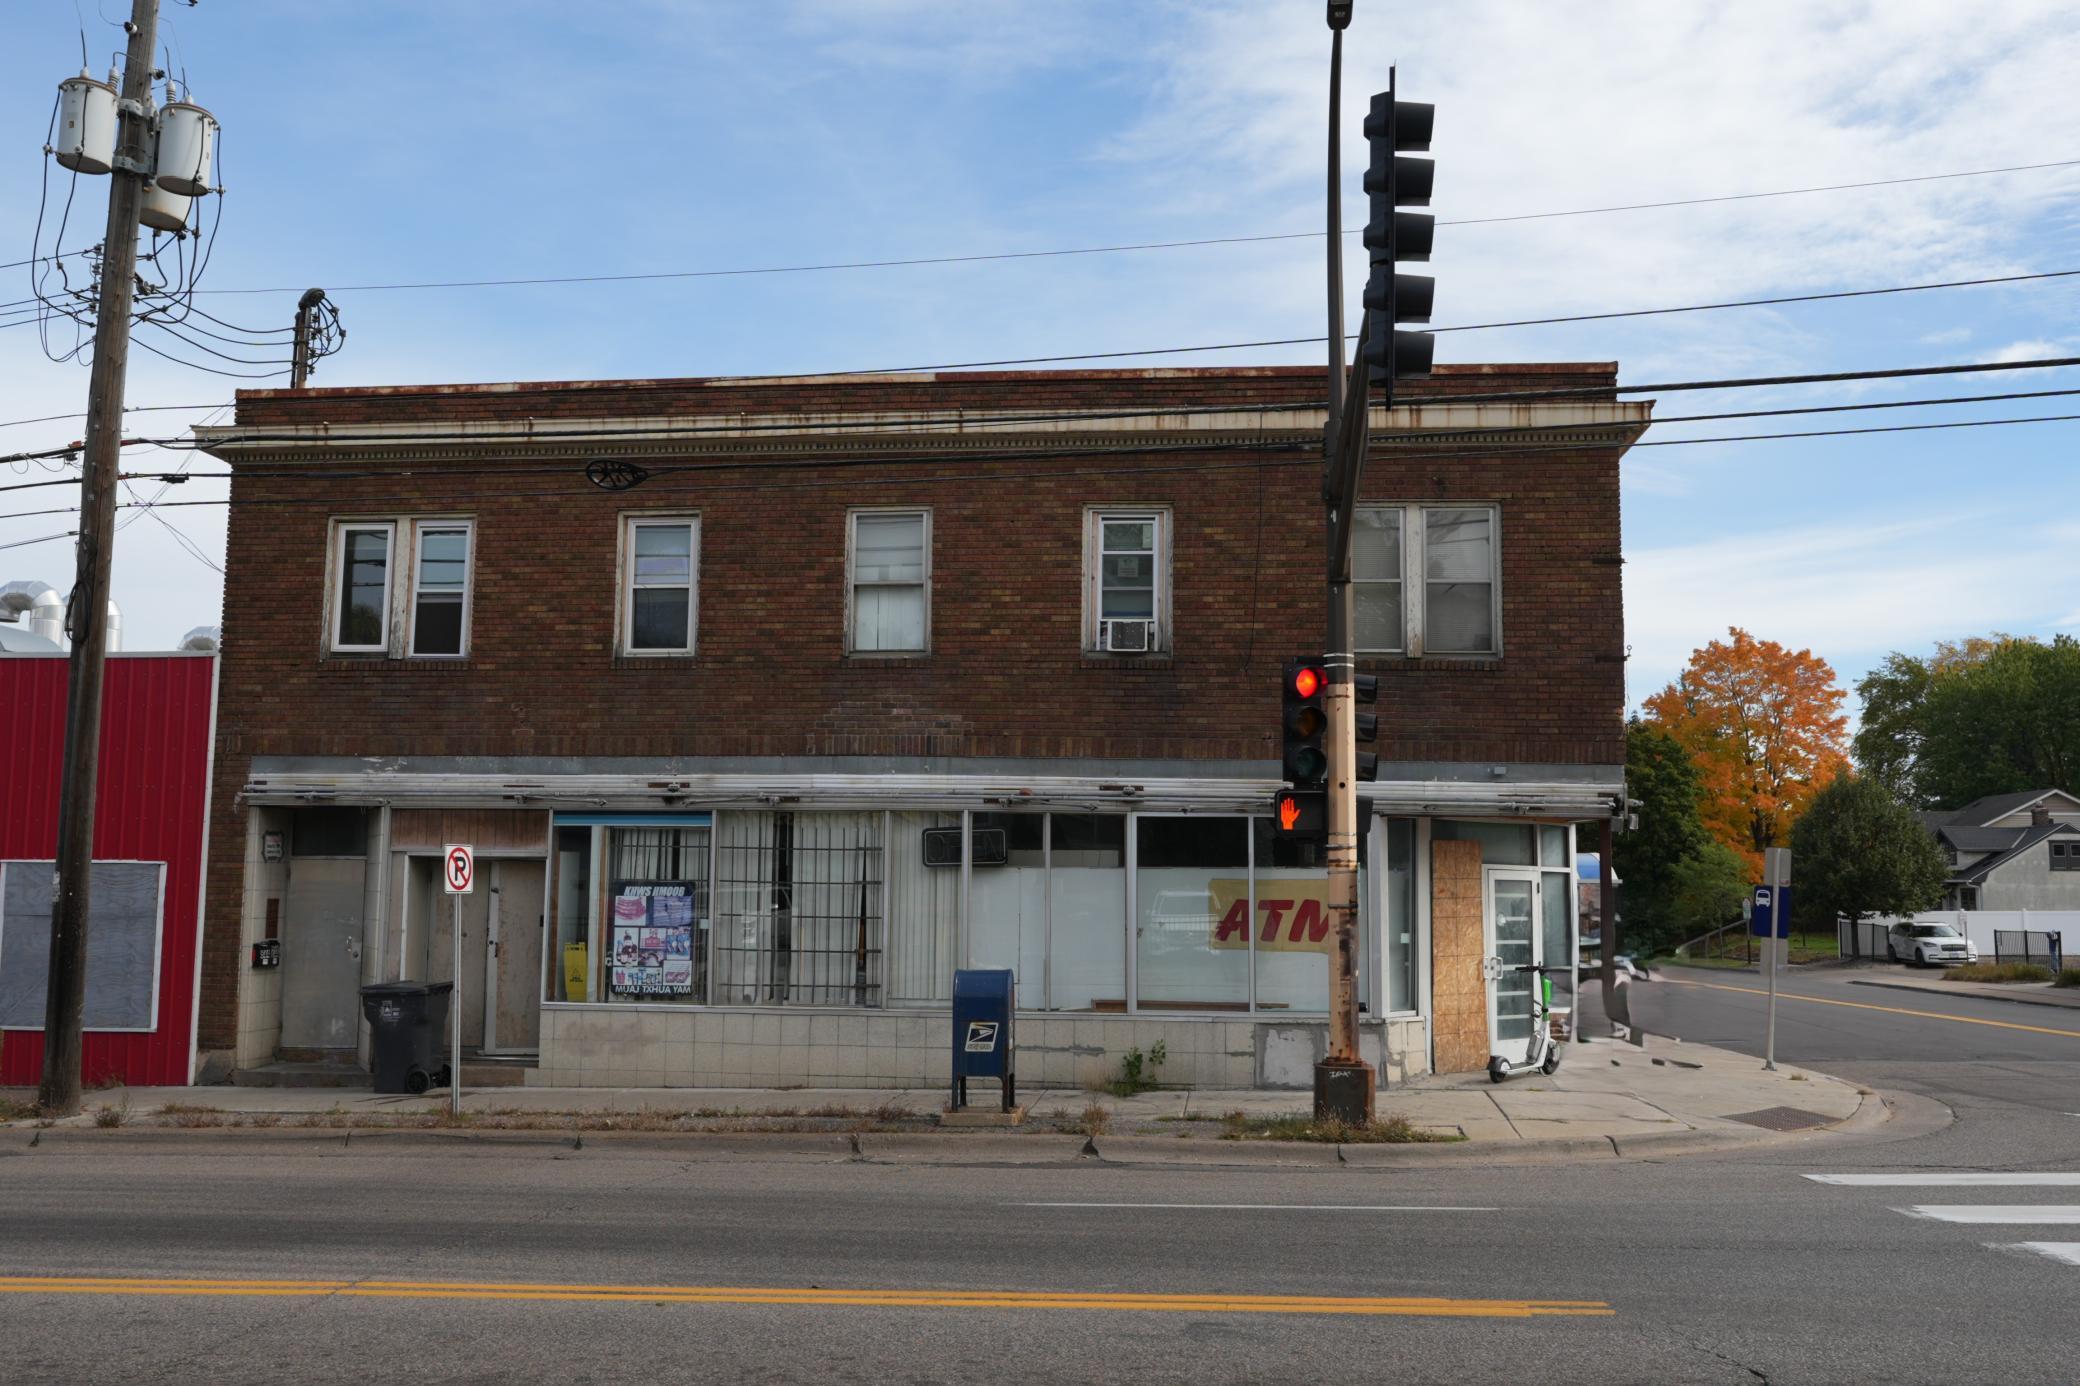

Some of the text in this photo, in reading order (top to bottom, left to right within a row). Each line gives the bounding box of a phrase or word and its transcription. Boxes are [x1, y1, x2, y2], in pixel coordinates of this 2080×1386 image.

[454, 856, 467, 882] P
[623, 886, 686, 897] KHWS HMOOB
[1215, 899, 1329, 943] ATM
[615, 985, 691, 994] MUAJ TXHUA YAM
